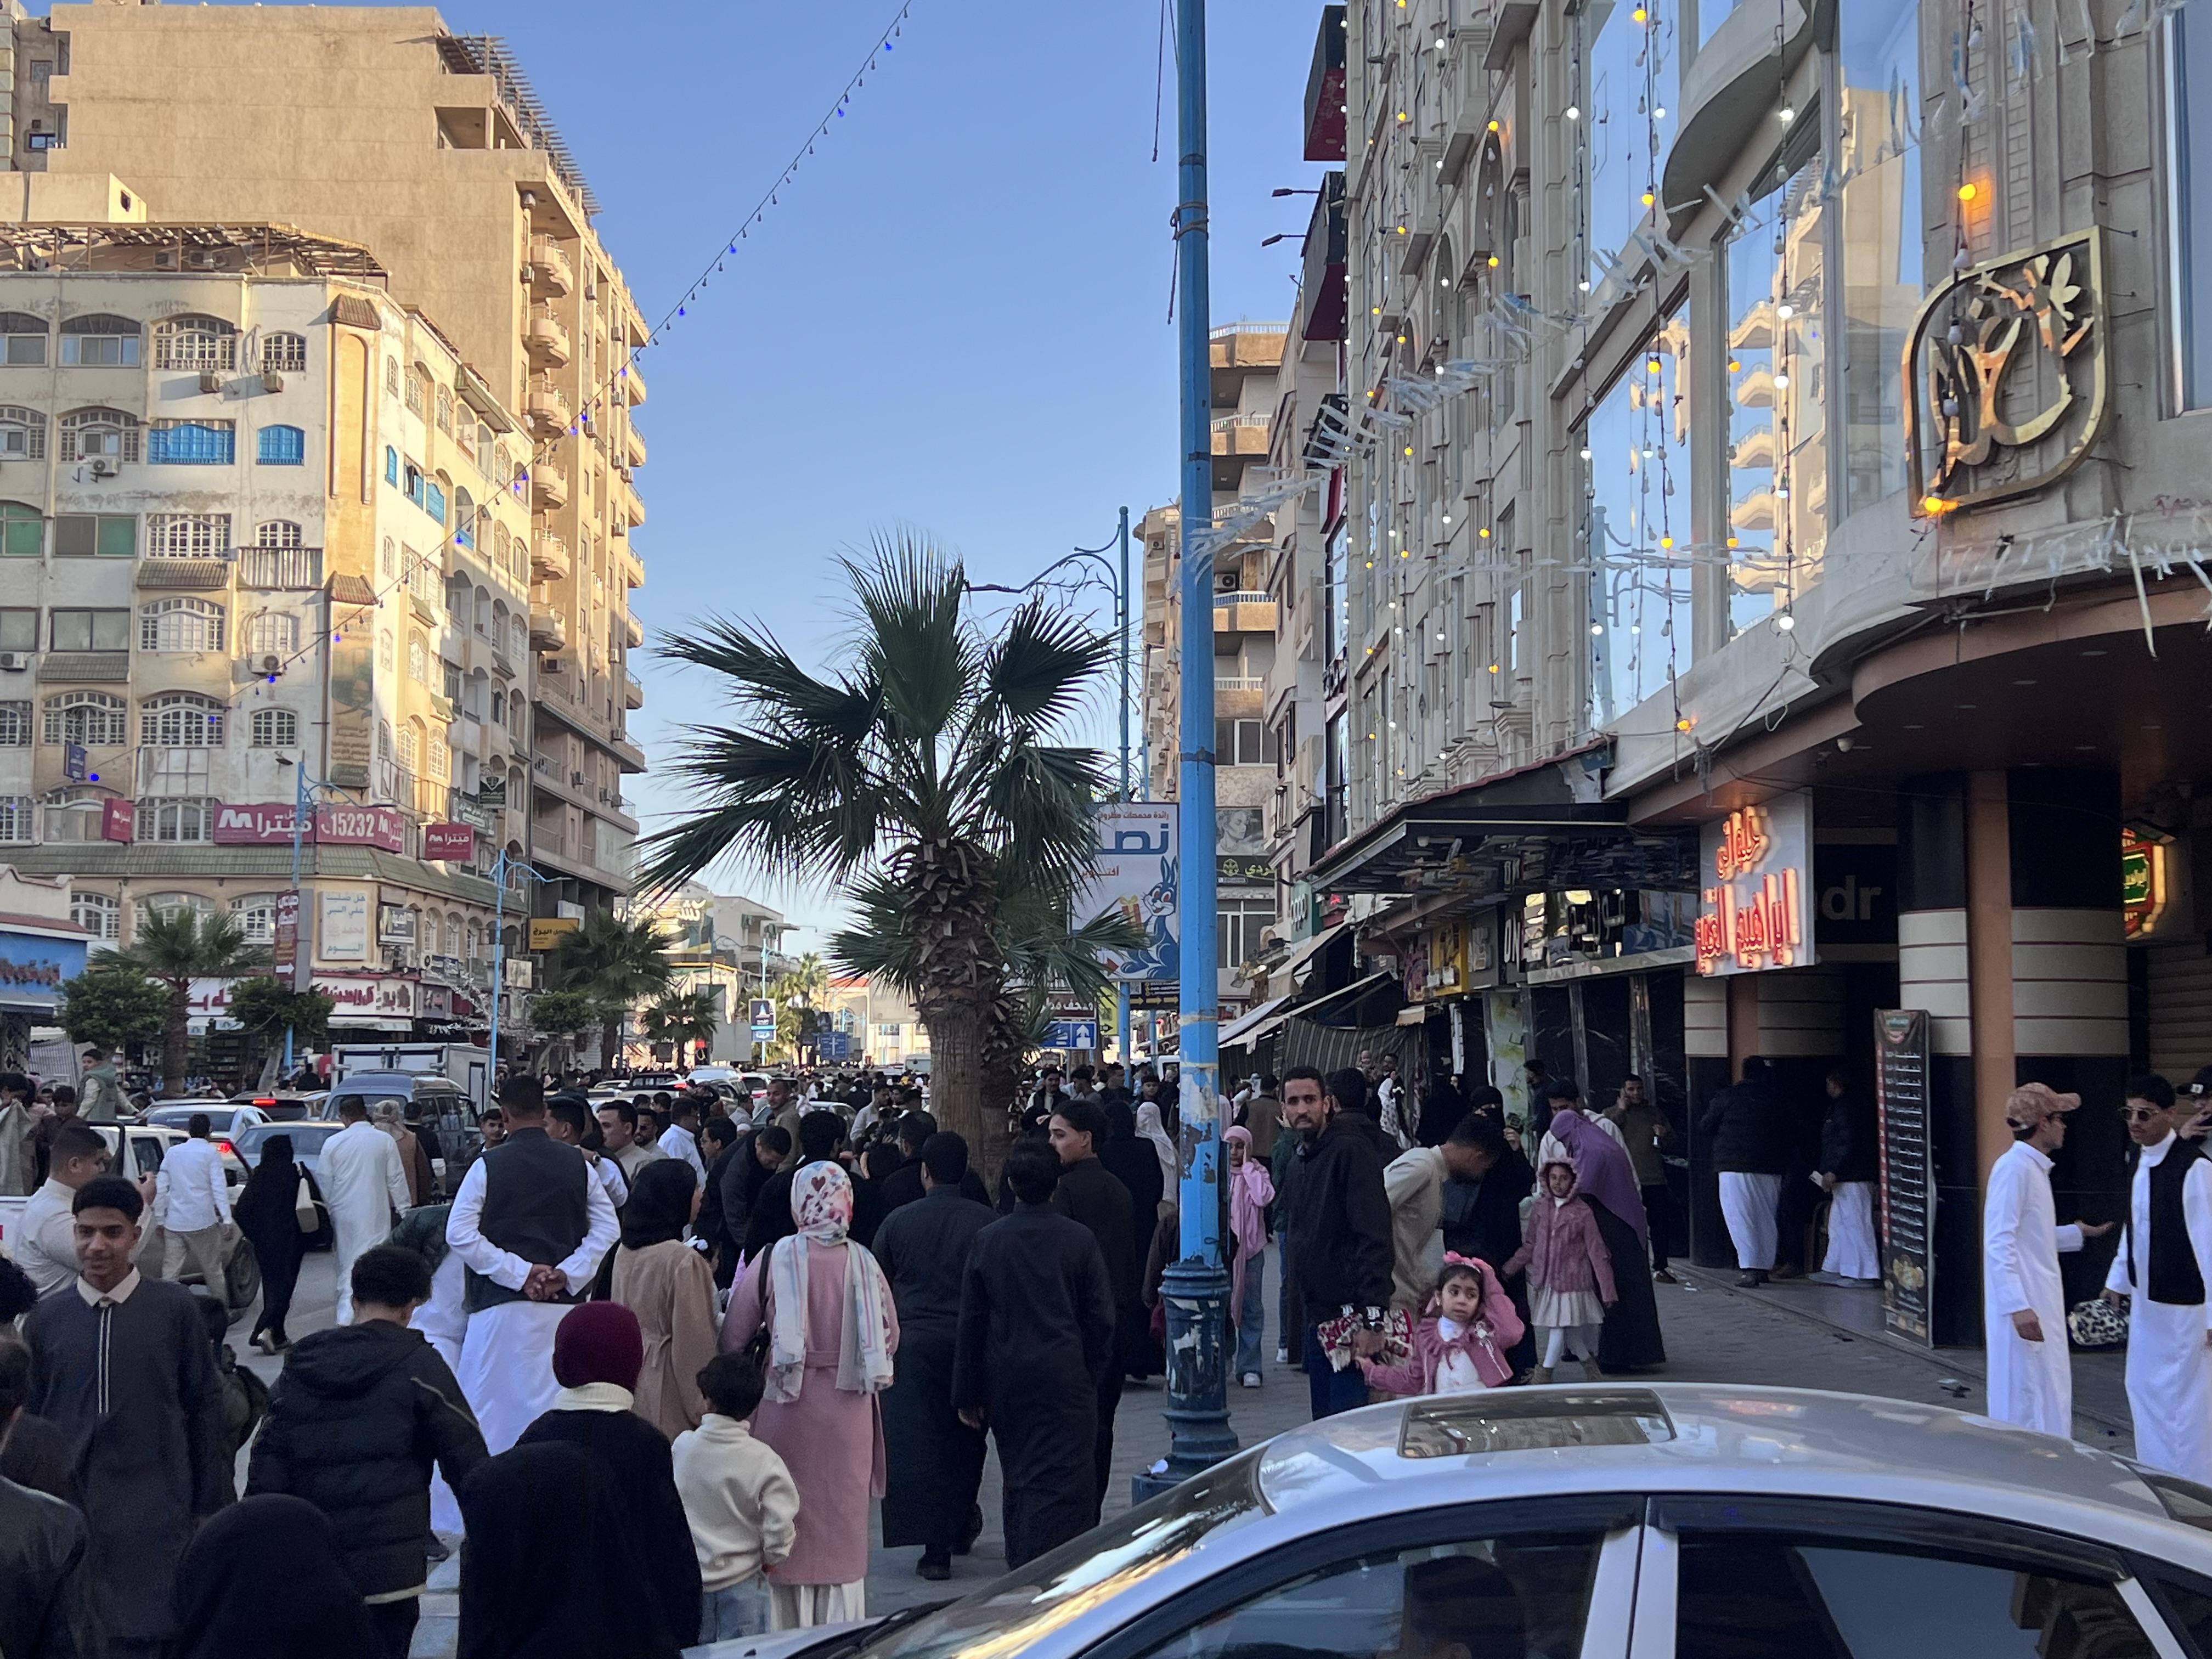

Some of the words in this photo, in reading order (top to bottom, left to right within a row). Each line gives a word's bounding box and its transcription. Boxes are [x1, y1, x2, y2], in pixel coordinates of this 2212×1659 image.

[1153, 811, 1169, 821] رائدة
[257, 812, 312, 838] ميترا
[331, 812, 375, 837] 15232
[444, 833, 469, 845] ميترا
[1094, 823, 1169, 855] نص
[353, 895, 365, 904] هل
[1815, 875, 1882, 921] dr
[348, 907, 364, 918] علي
[326, 943, 363, 955] اليوم
